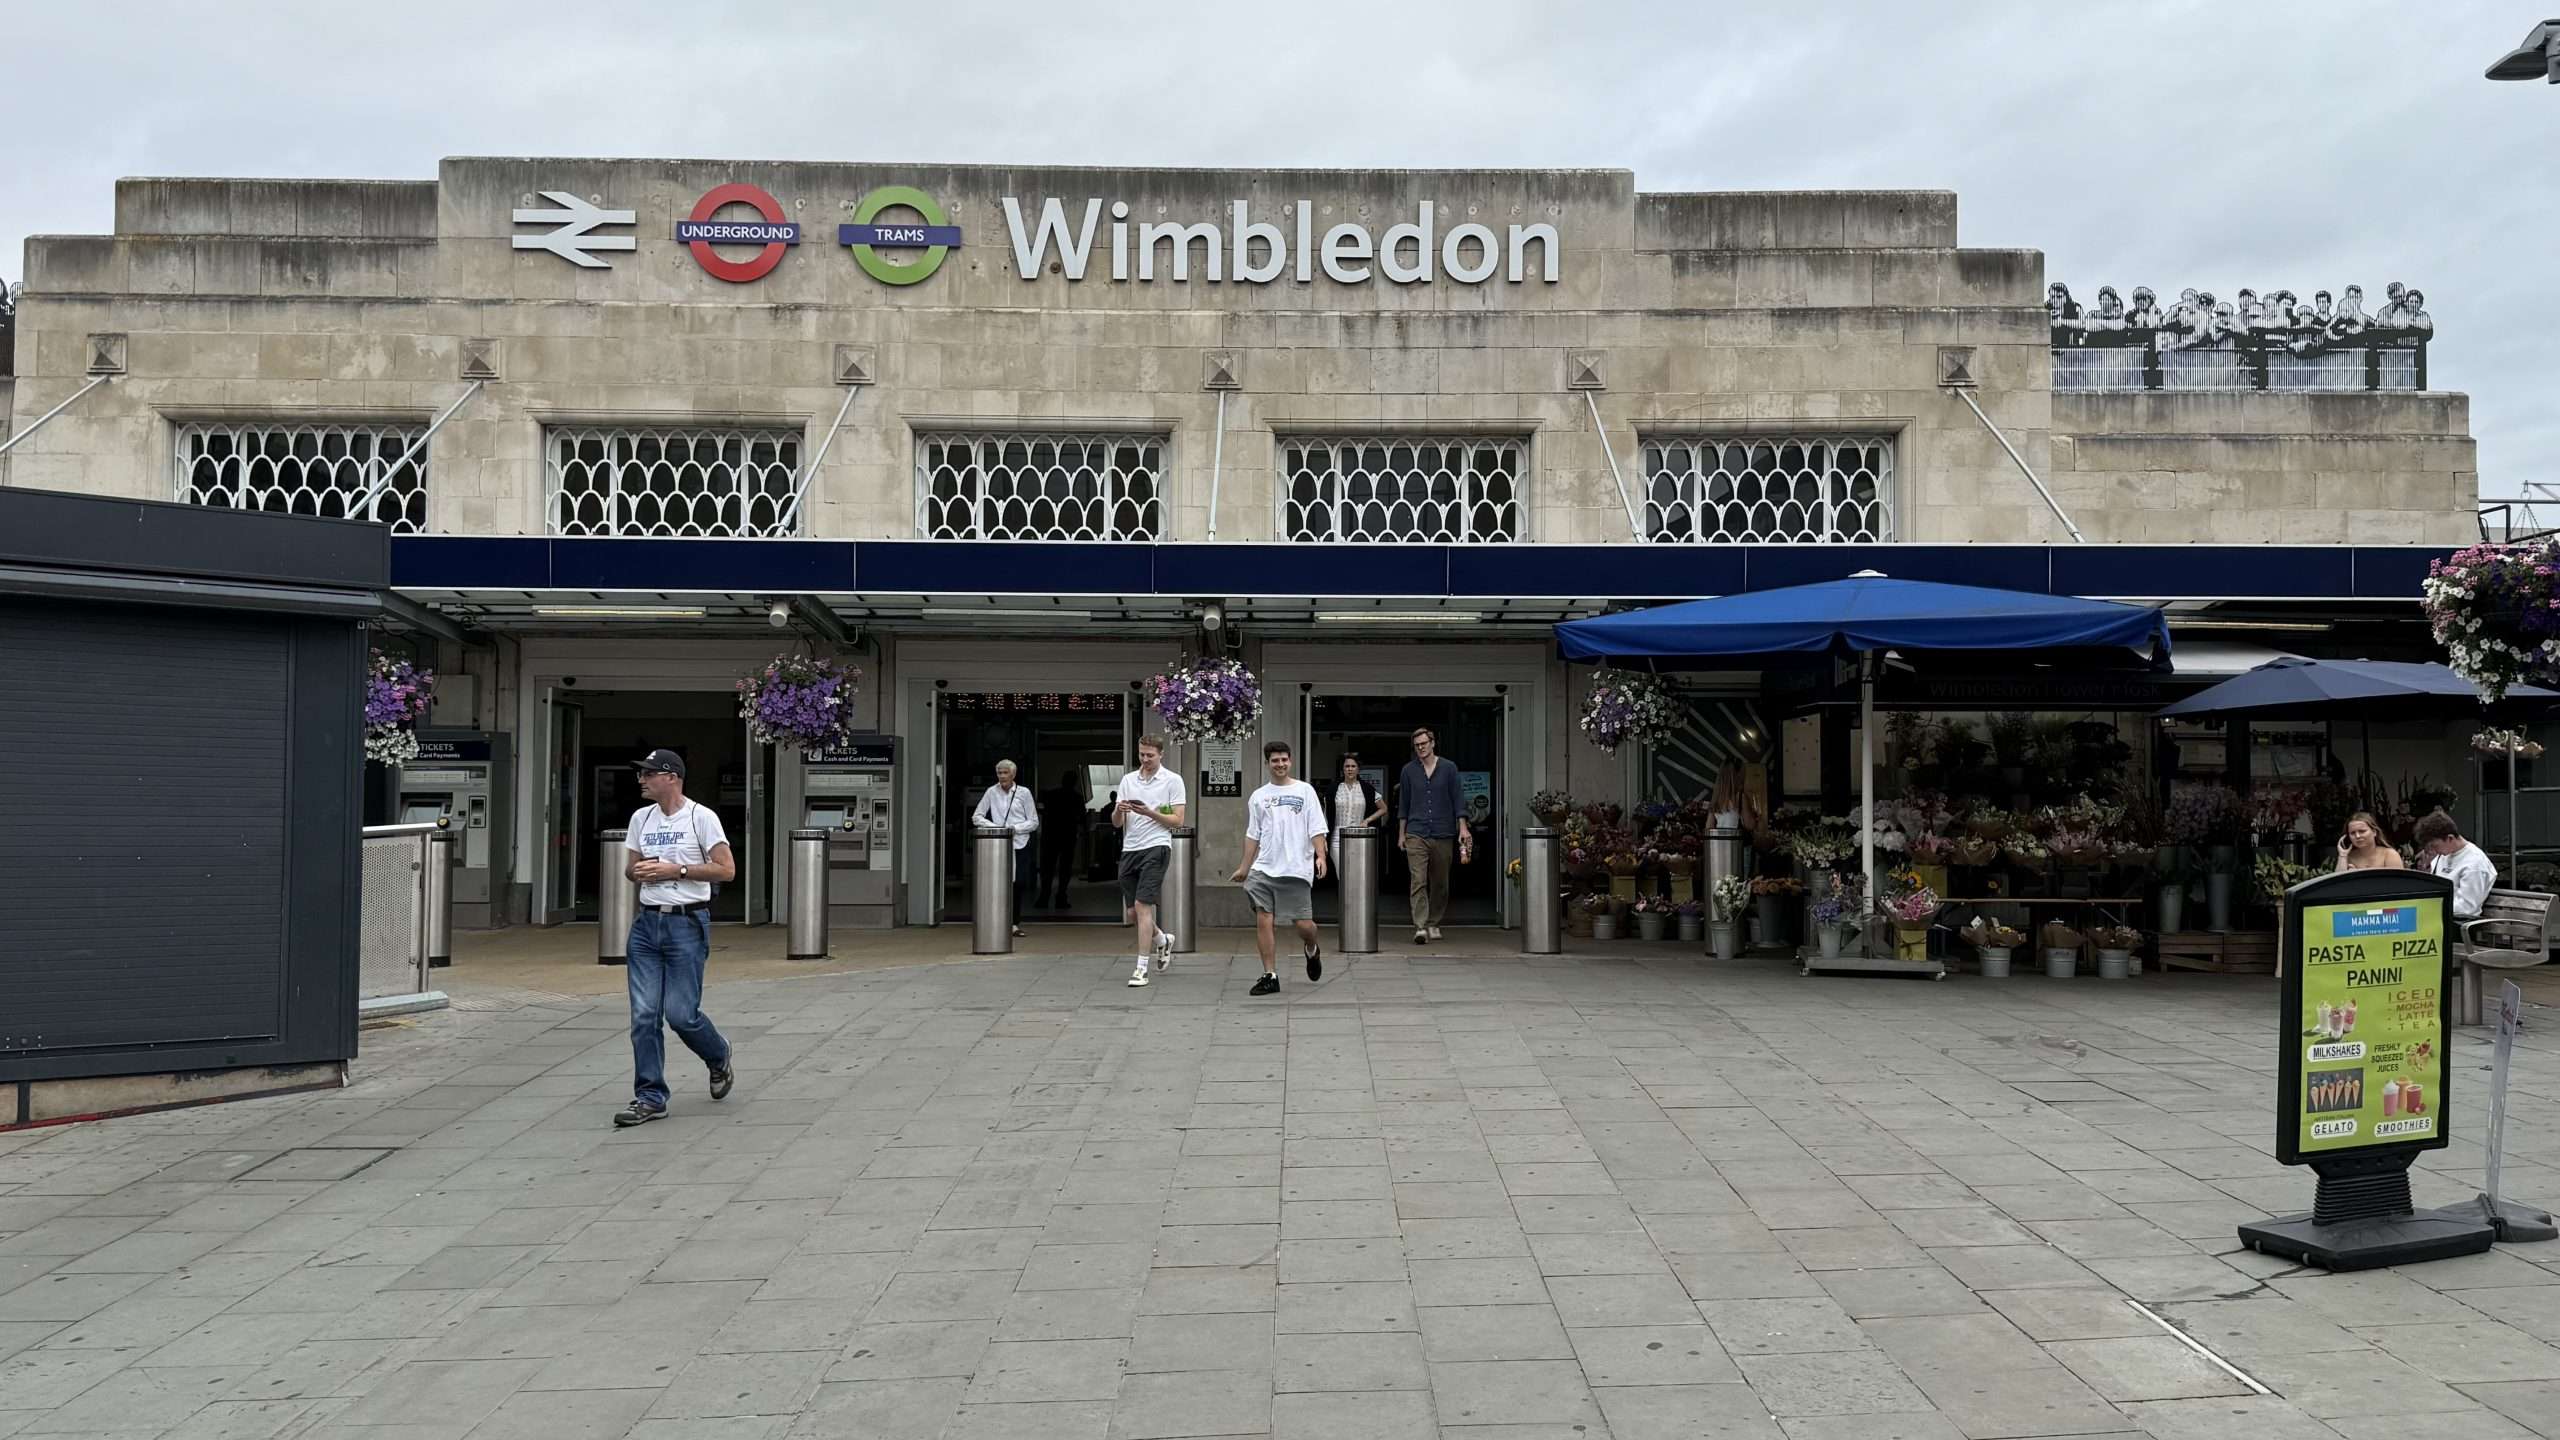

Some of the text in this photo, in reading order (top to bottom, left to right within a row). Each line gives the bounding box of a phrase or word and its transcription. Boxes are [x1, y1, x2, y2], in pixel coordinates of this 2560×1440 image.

[681, 225, 794, 239] UNDERGROUND
[875, 228, 925, 242] TRAMS
[1000, 196, 1560, 284] Wimbledon
[420, 743, 454, 751] TICKETS
[2351, 915, 2380, 927] MAMMA
[2308, 944, 2366, 963] PASTA
[2392, 938, 2438, 957] PIZZA
[2347, 967, 2402, 986] PANINI
[2388, 988, 2435, 1003] ICED
[2396, 1001, 2434, 1012] MOCHA
[2399, 1010, 2433, 1021] LATTE
[2313, 1044, 2361, 1058] MILKSHAKES
[2374, 1043, 2401, 1052] FRESHLY
[2371, 1052, 2404, 1063] SQUEEZED
[2376, 1063, 2400, 1073] JUICES
[2314, 1121, 2354, 1134] GELATO
[2376, 1118, 2431, 1133] SMOOTHIES
